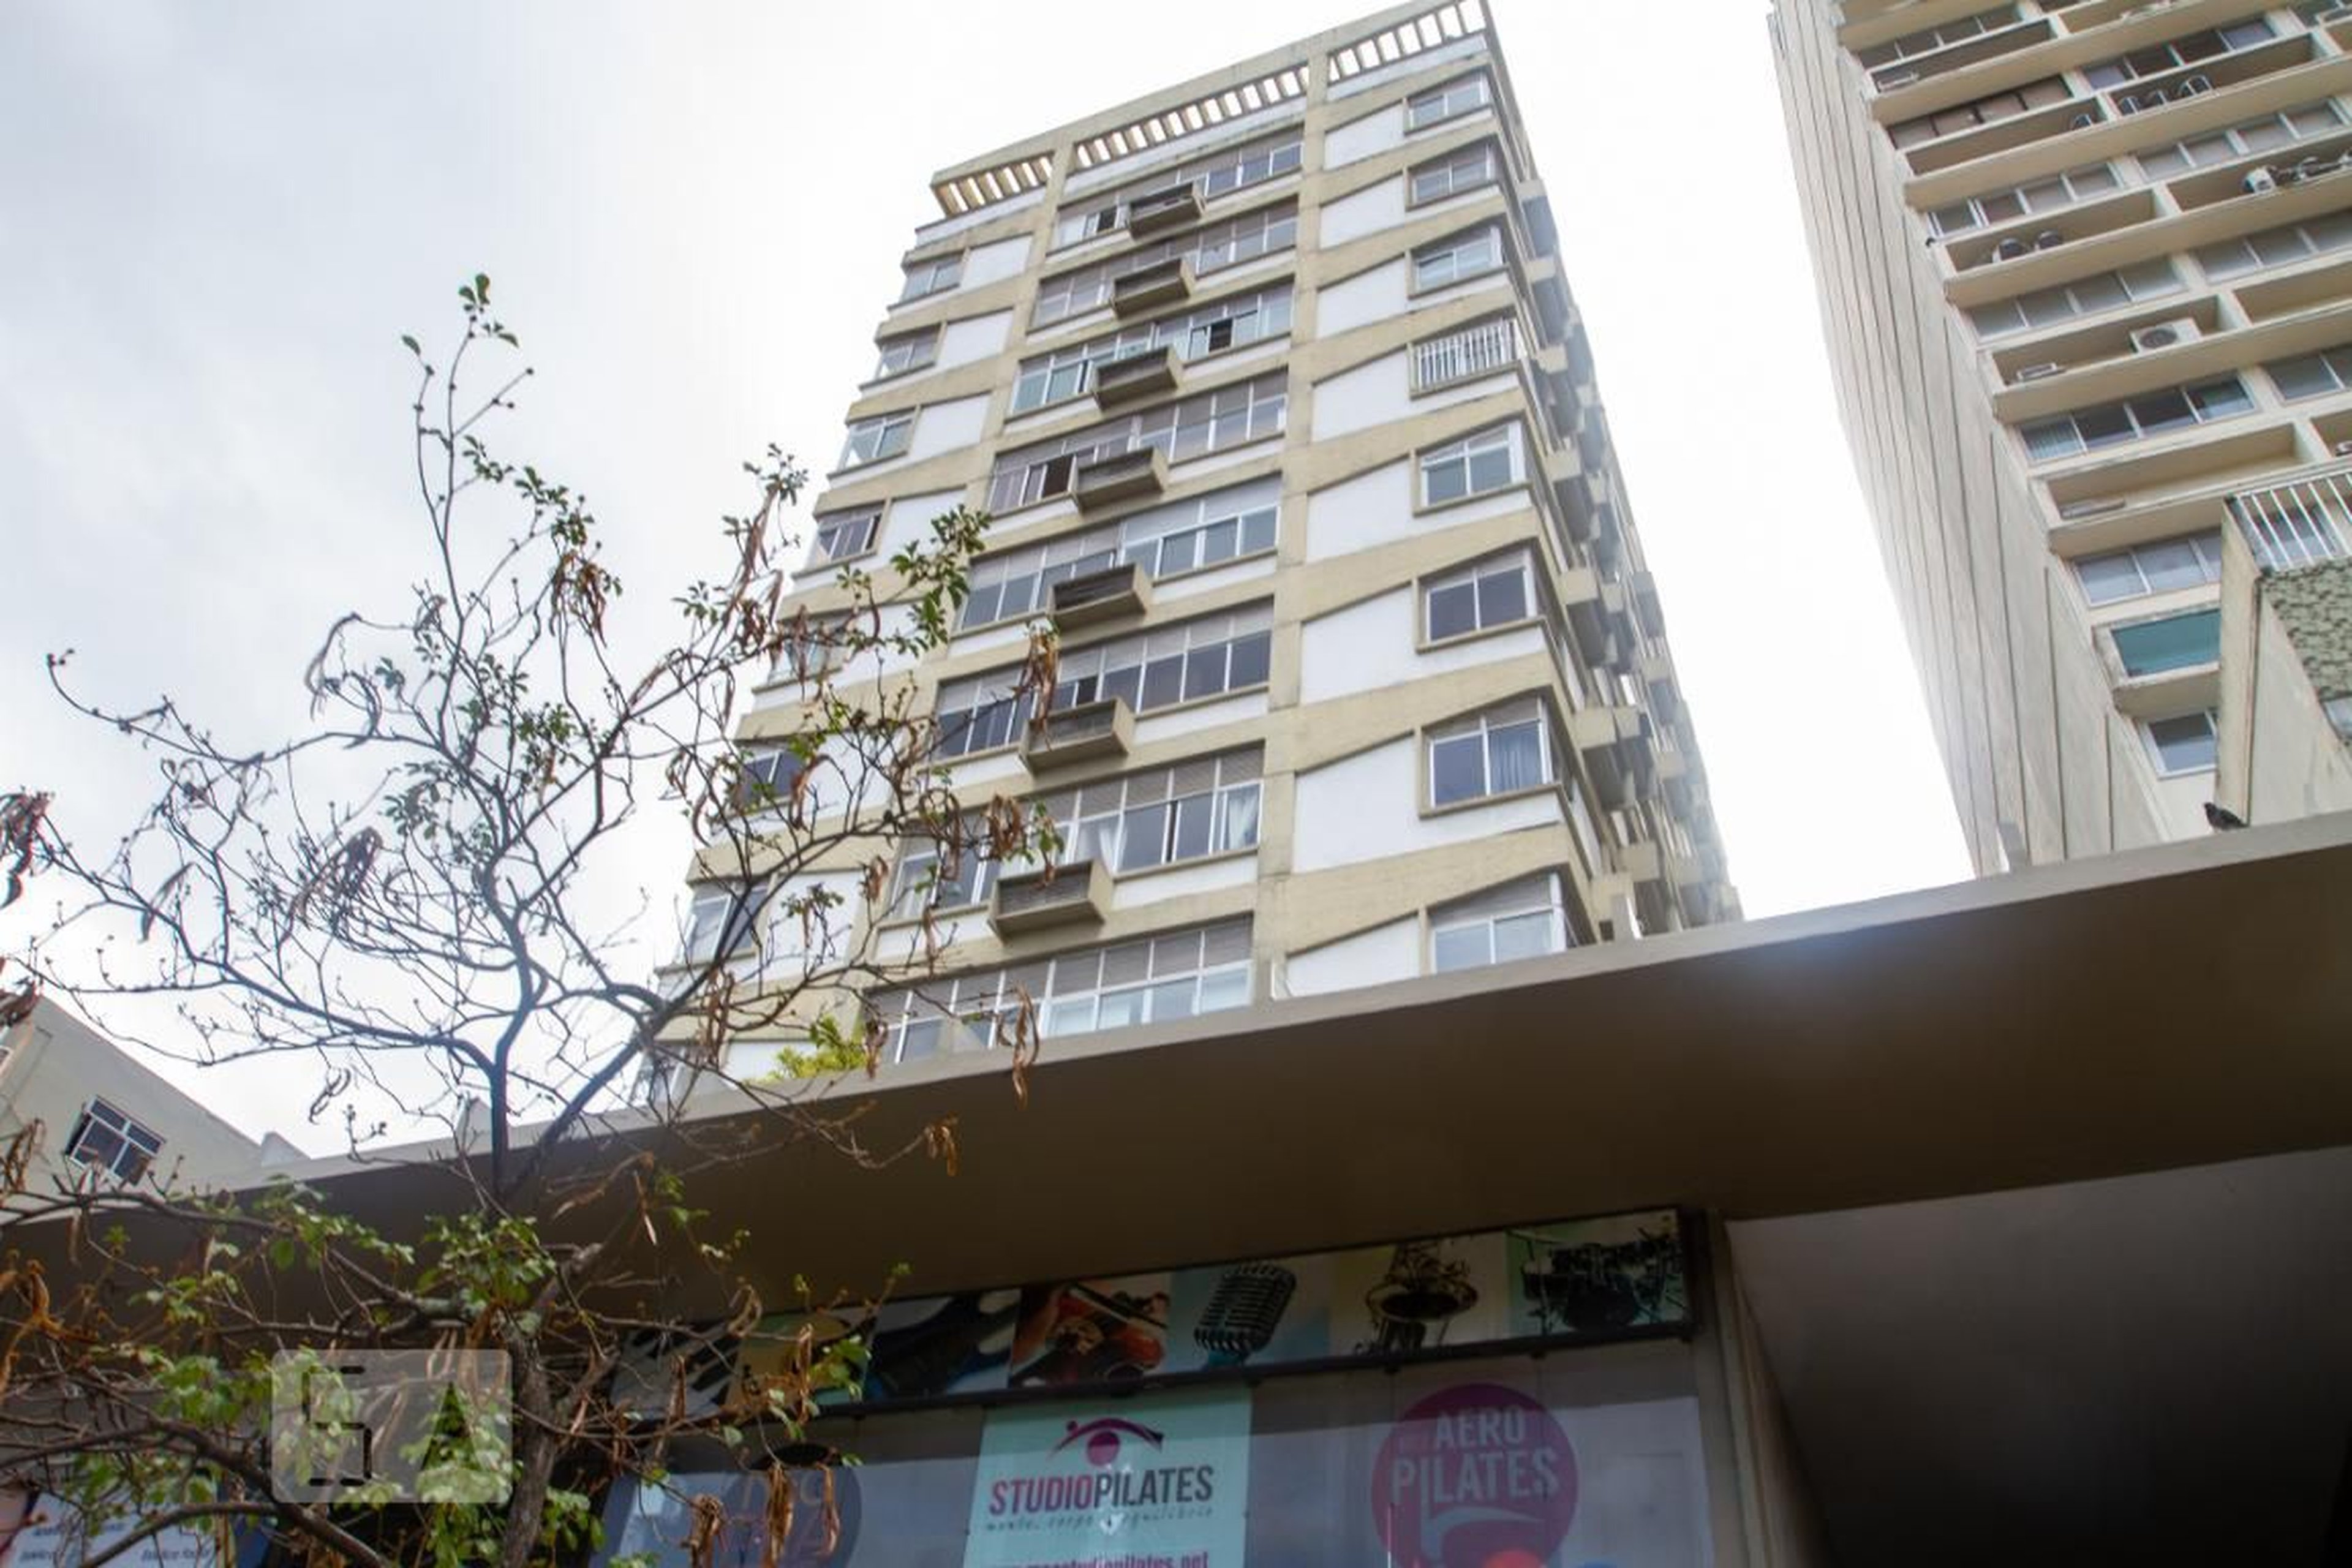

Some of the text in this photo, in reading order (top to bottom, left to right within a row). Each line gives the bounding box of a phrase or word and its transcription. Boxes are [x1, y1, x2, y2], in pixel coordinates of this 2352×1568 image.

[1436, 1406, 1526, 1448] AERO
[989, 1464, 1214, 1515] STUDIOPILATES
[1391, 1446, 1560, 1505] PILATES
